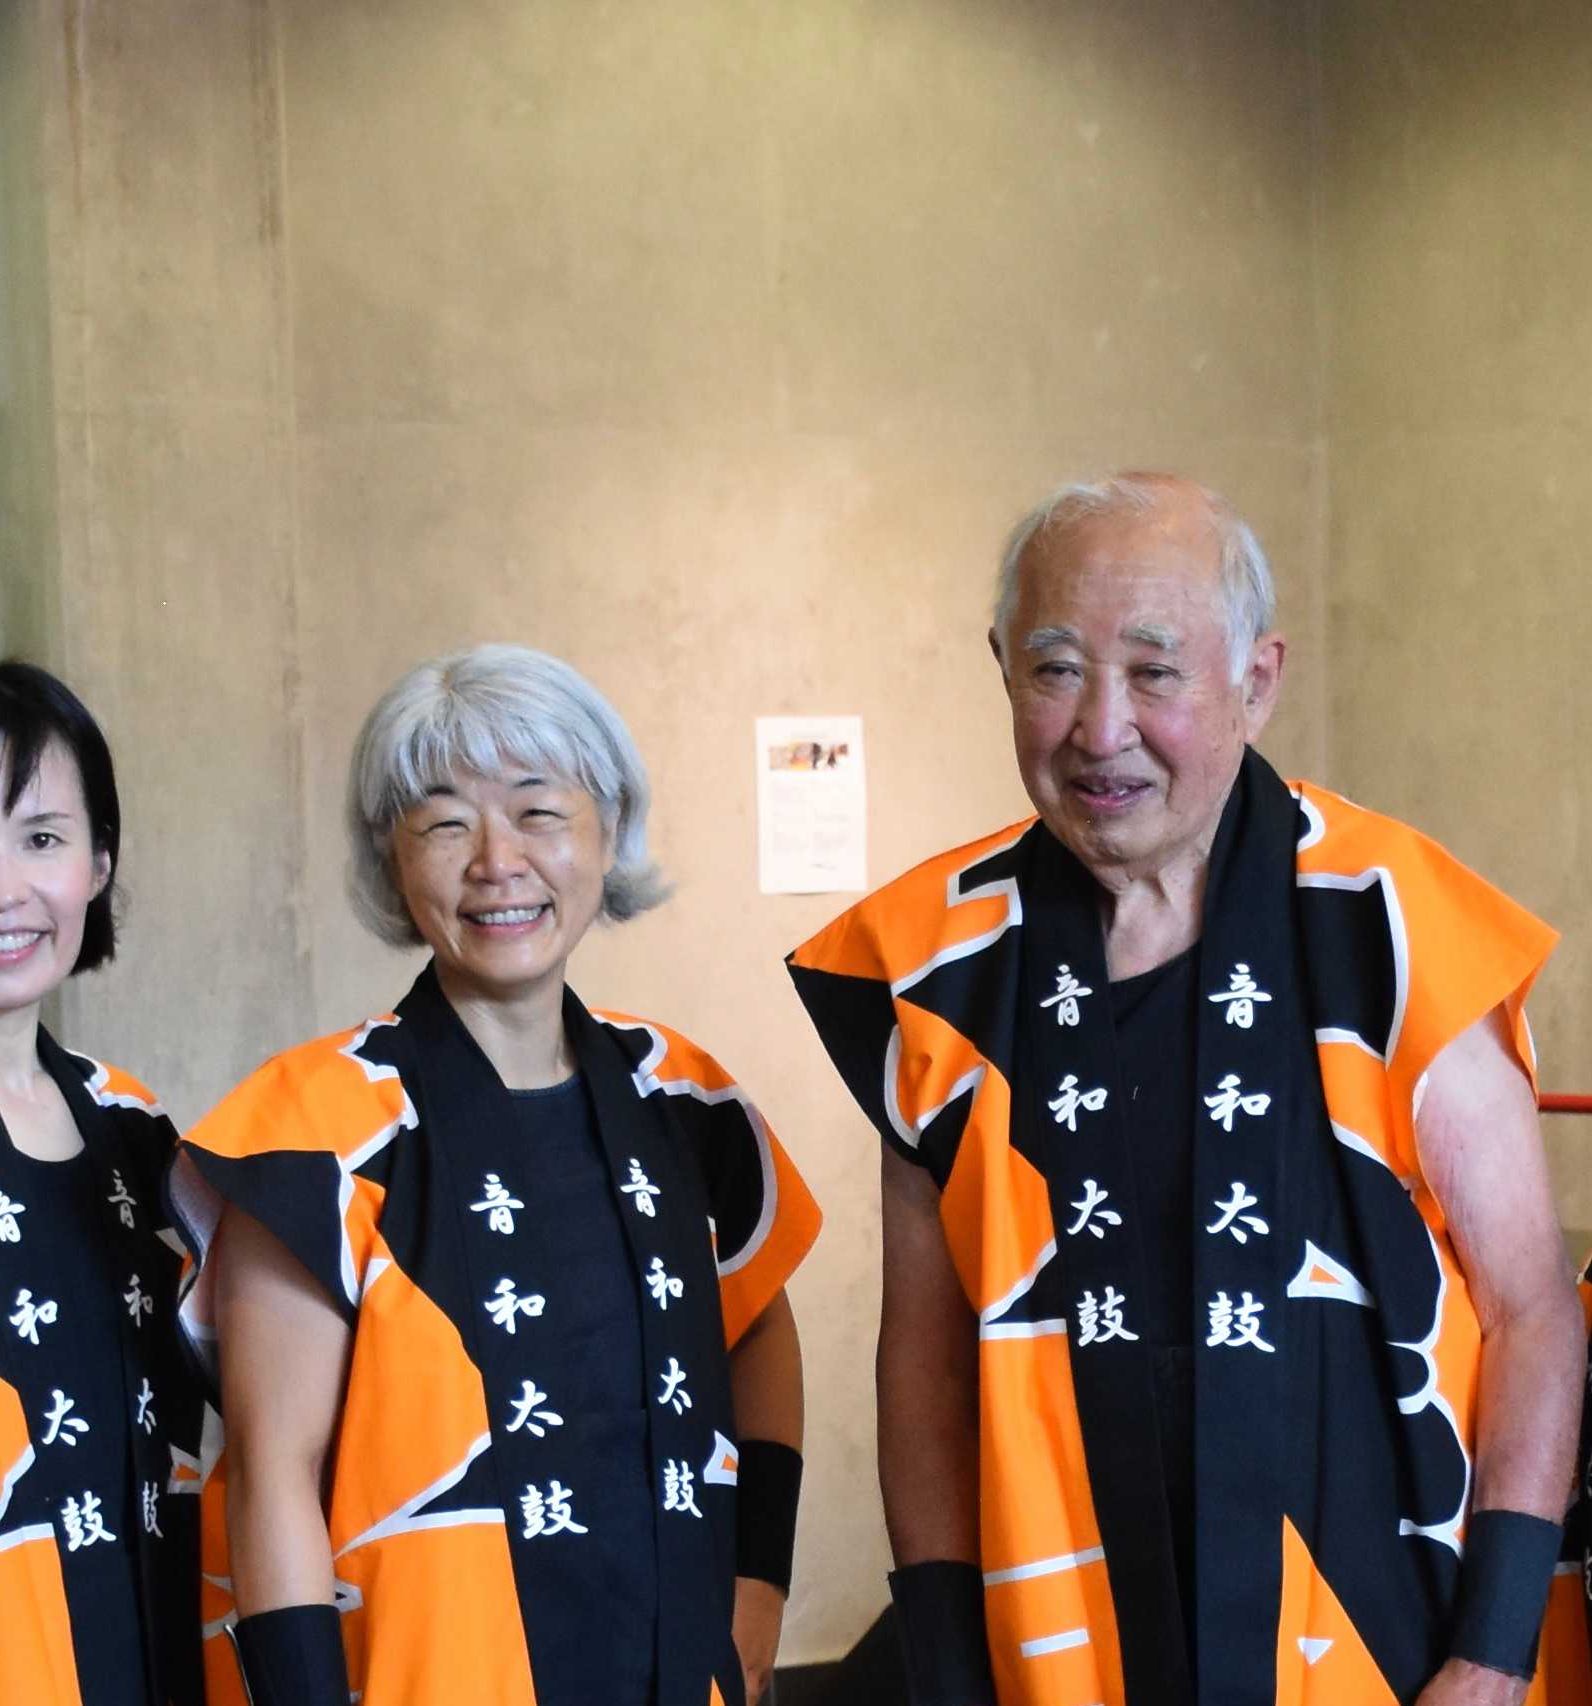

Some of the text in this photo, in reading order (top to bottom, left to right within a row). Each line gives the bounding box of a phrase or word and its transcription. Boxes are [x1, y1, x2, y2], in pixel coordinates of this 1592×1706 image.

[620, 1158, 703, 1519] 音和太鼓
[1039, 963, 1140, 1348] 音和太鼓
[1203, 963, 1276, 1354] 音和太鼓
[108, 1169, 164, 1539] 音和太鼓
[470, 1174, 589, 1540] 音和太鼓
